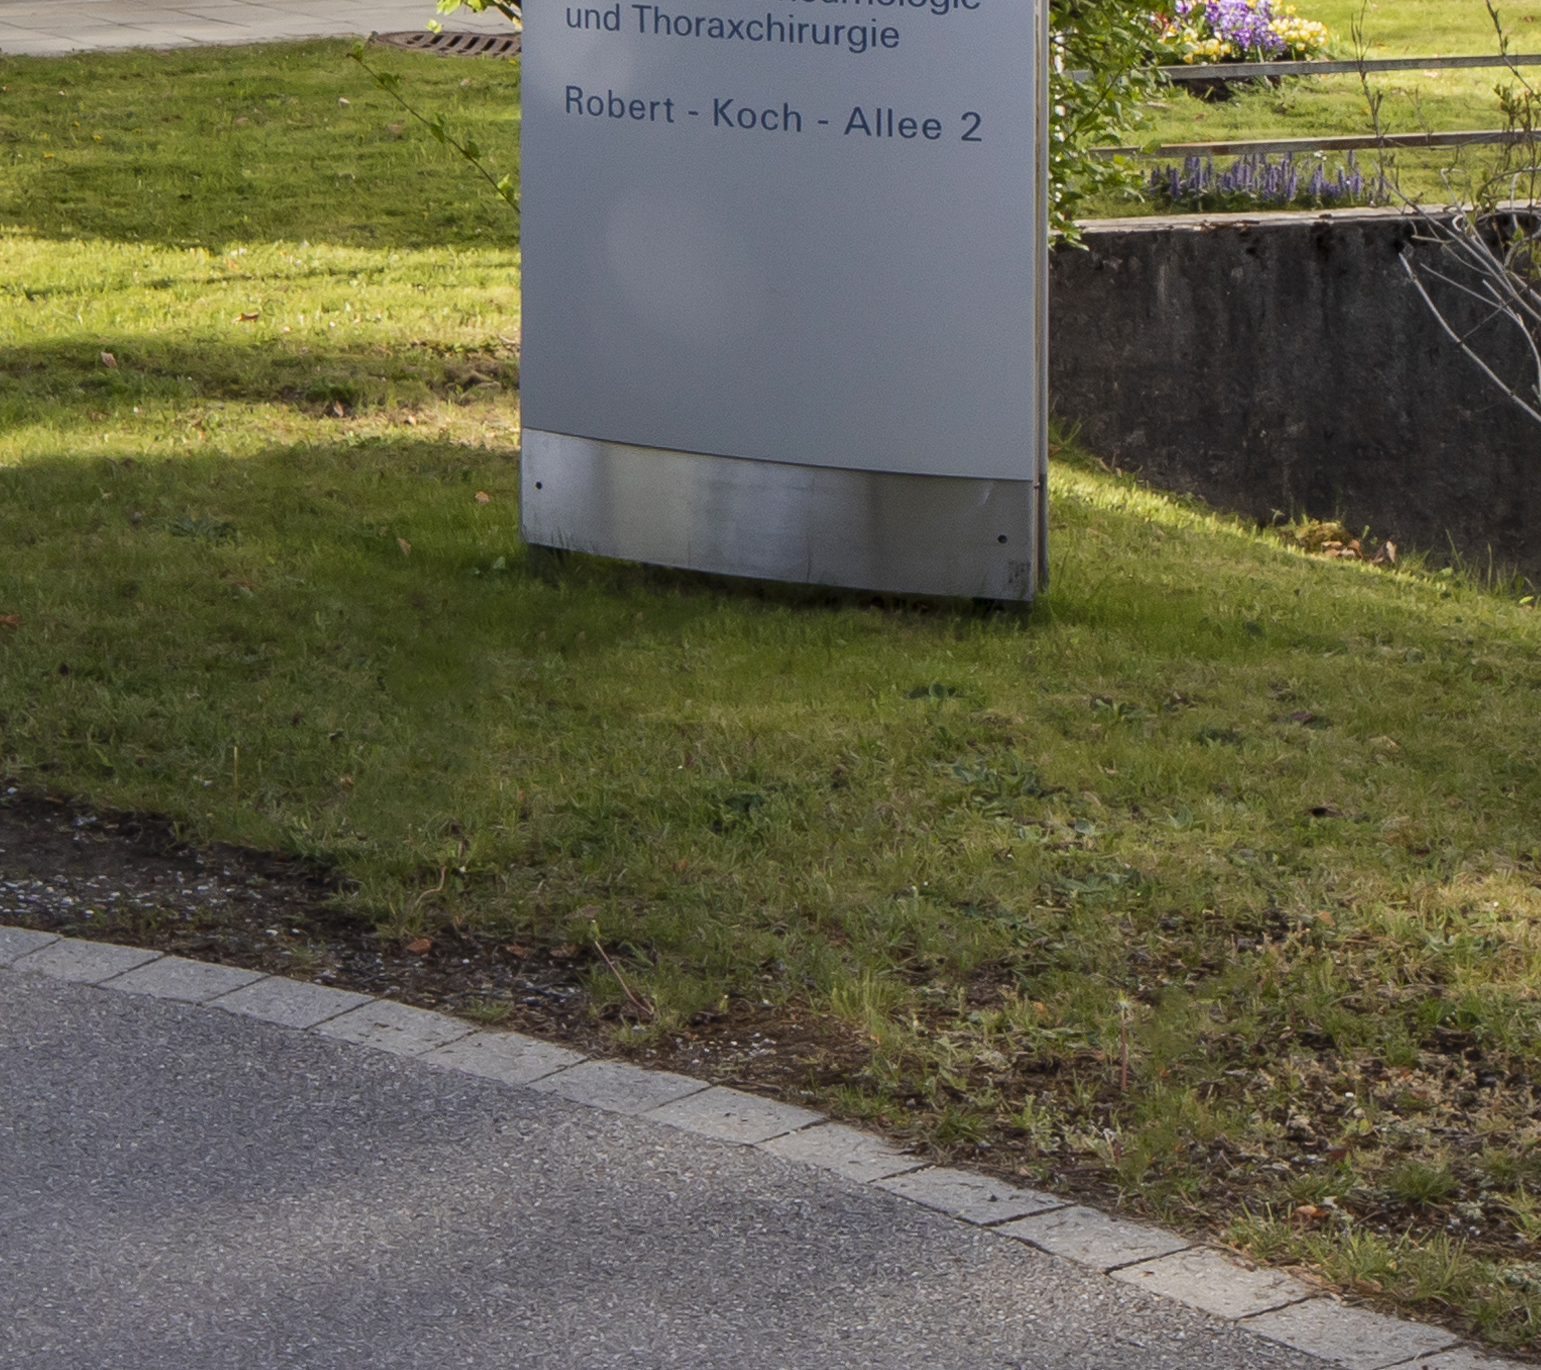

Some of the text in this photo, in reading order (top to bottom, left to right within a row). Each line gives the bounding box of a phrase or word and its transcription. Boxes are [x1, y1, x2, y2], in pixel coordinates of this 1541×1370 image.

[566, 2, 900, 54] und Thoraxchirurgie
[565, 85, 675, 124] Robert
[713, 98, 802, 133] Koch
[843, 106, 942, 141] Allee
[960, 111, 983, 142] 2
